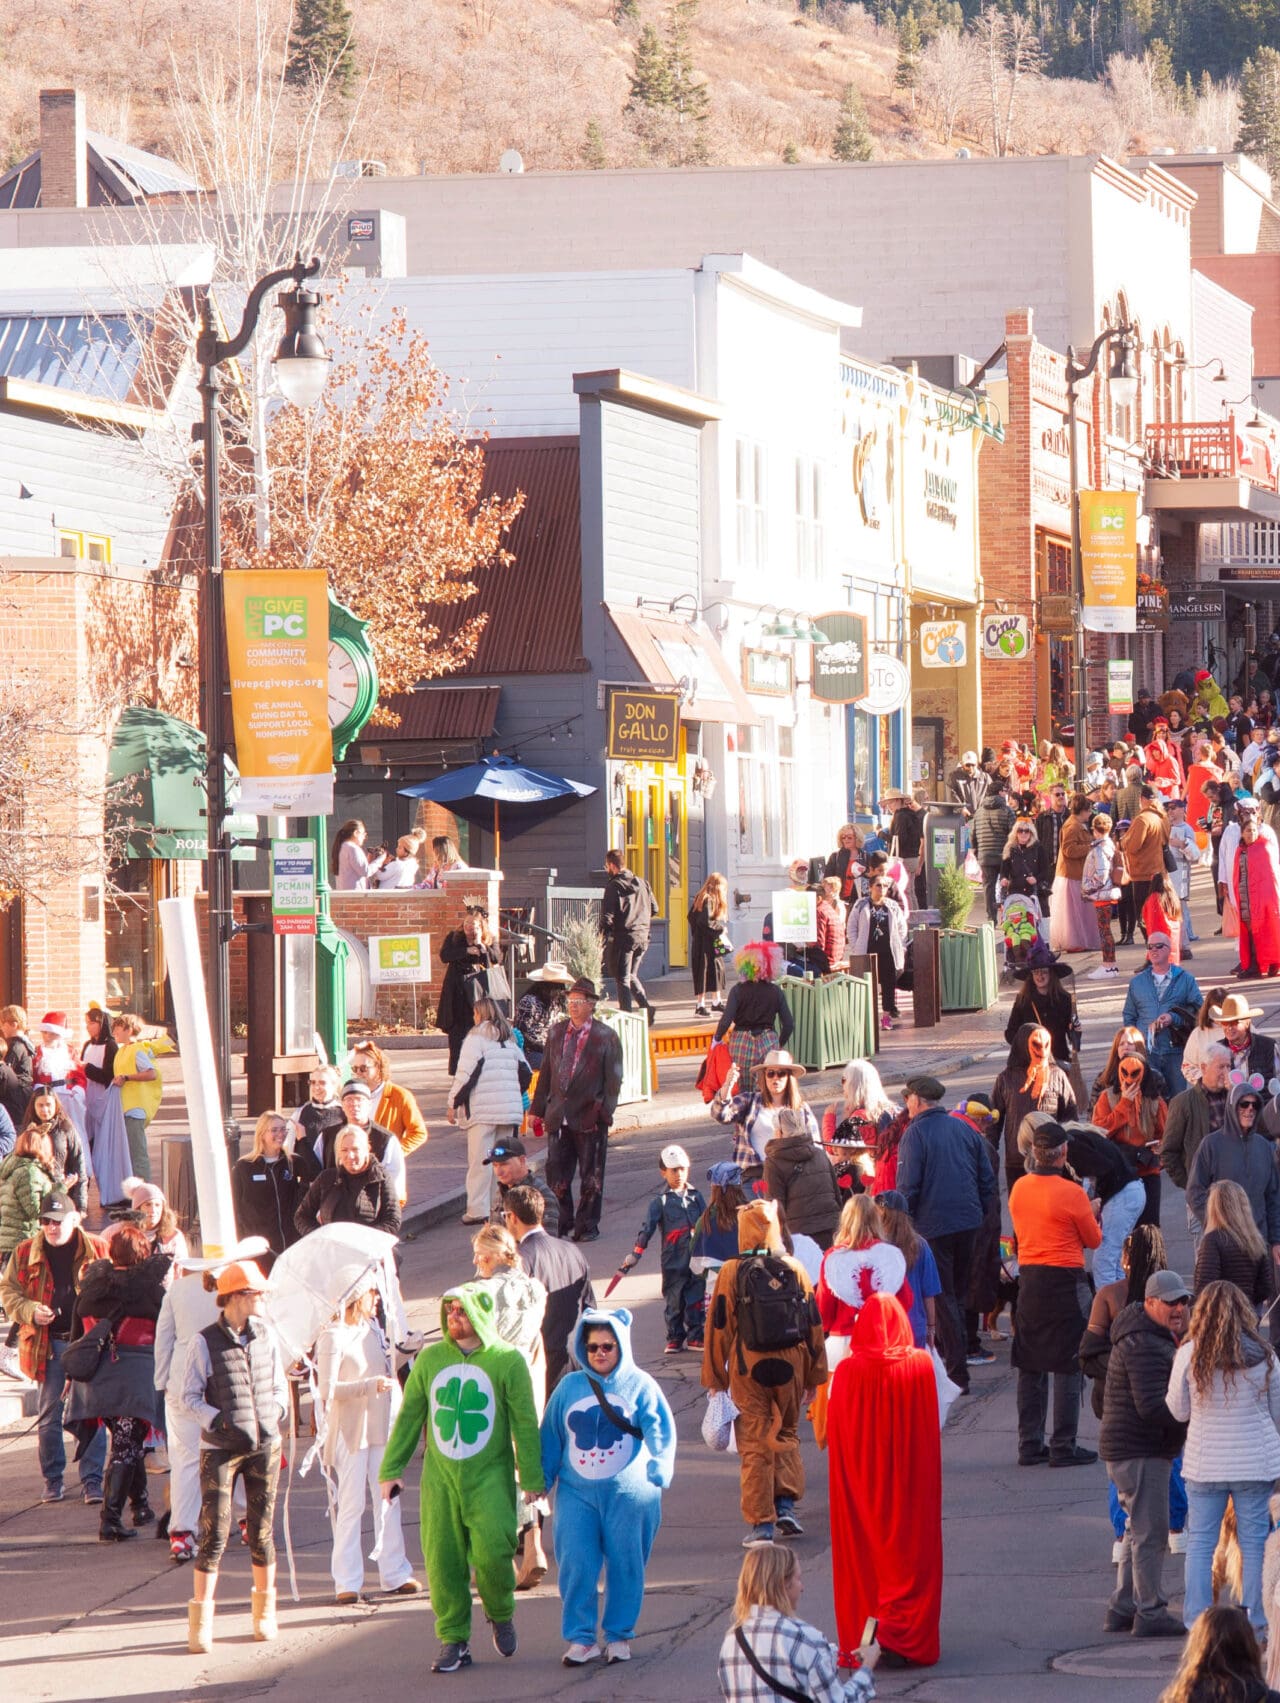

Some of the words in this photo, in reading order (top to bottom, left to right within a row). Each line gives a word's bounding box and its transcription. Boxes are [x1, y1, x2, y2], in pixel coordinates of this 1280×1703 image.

[1101, 516, 1124, 529] PC
[264, 599, 305, 614] GIVE
[264, 614, 304, 636] PC
[246, 648, 307, 657] COMMUNITY
[246, 657, 307, 667] FOUNDATION
[820, 664, 858, 675] Roots
[233, 678, 324, 690] livepcgivepc.org
[271, 701, 304, 709] ANNUAL
[251, 712, 279, 720] GIVING
[298, 710, 308, 718] TO
[625, 702, 656, 720] DON
[248, 721, 286, 729] SUPPORT
[287, 719, 313, 727] LOCAL
[255, 729, 309, 738] NONPROFITS
[618, 721, 669, 742] GALLO
[277, 882, 311, 891] PCMAIN
[280, 895, 309, 905] 25023
[393, 950, 419, 966] PC
